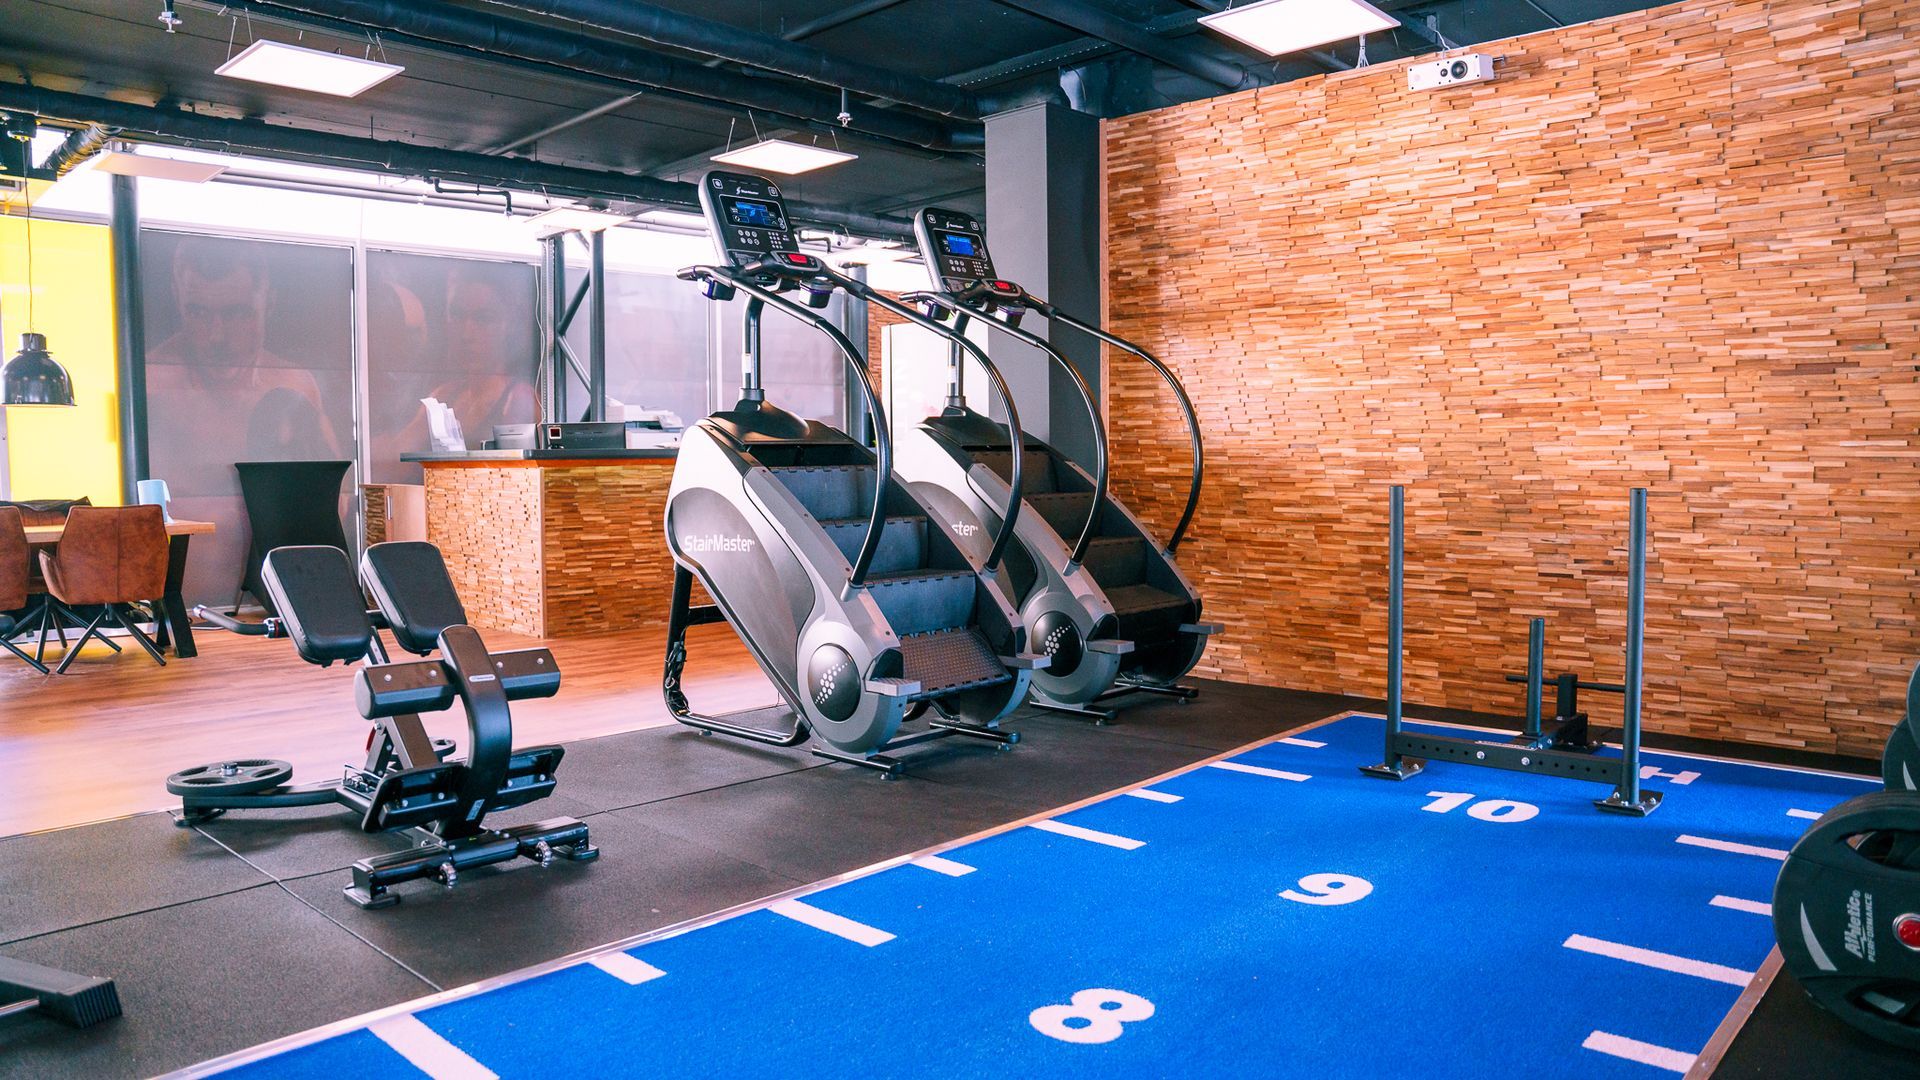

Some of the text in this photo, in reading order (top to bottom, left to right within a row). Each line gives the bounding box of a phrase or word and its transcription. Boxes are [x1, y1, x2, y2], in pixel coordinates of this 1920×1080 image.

[685, 534, 754, 553] StairMaster
[1421, 790, 1540, 822] 10
[1278, 873, 1374, 906] 9
[1864, 892, 1876, 962] PERFORMANCE
[1029, 987, 1156, 1044] 8
